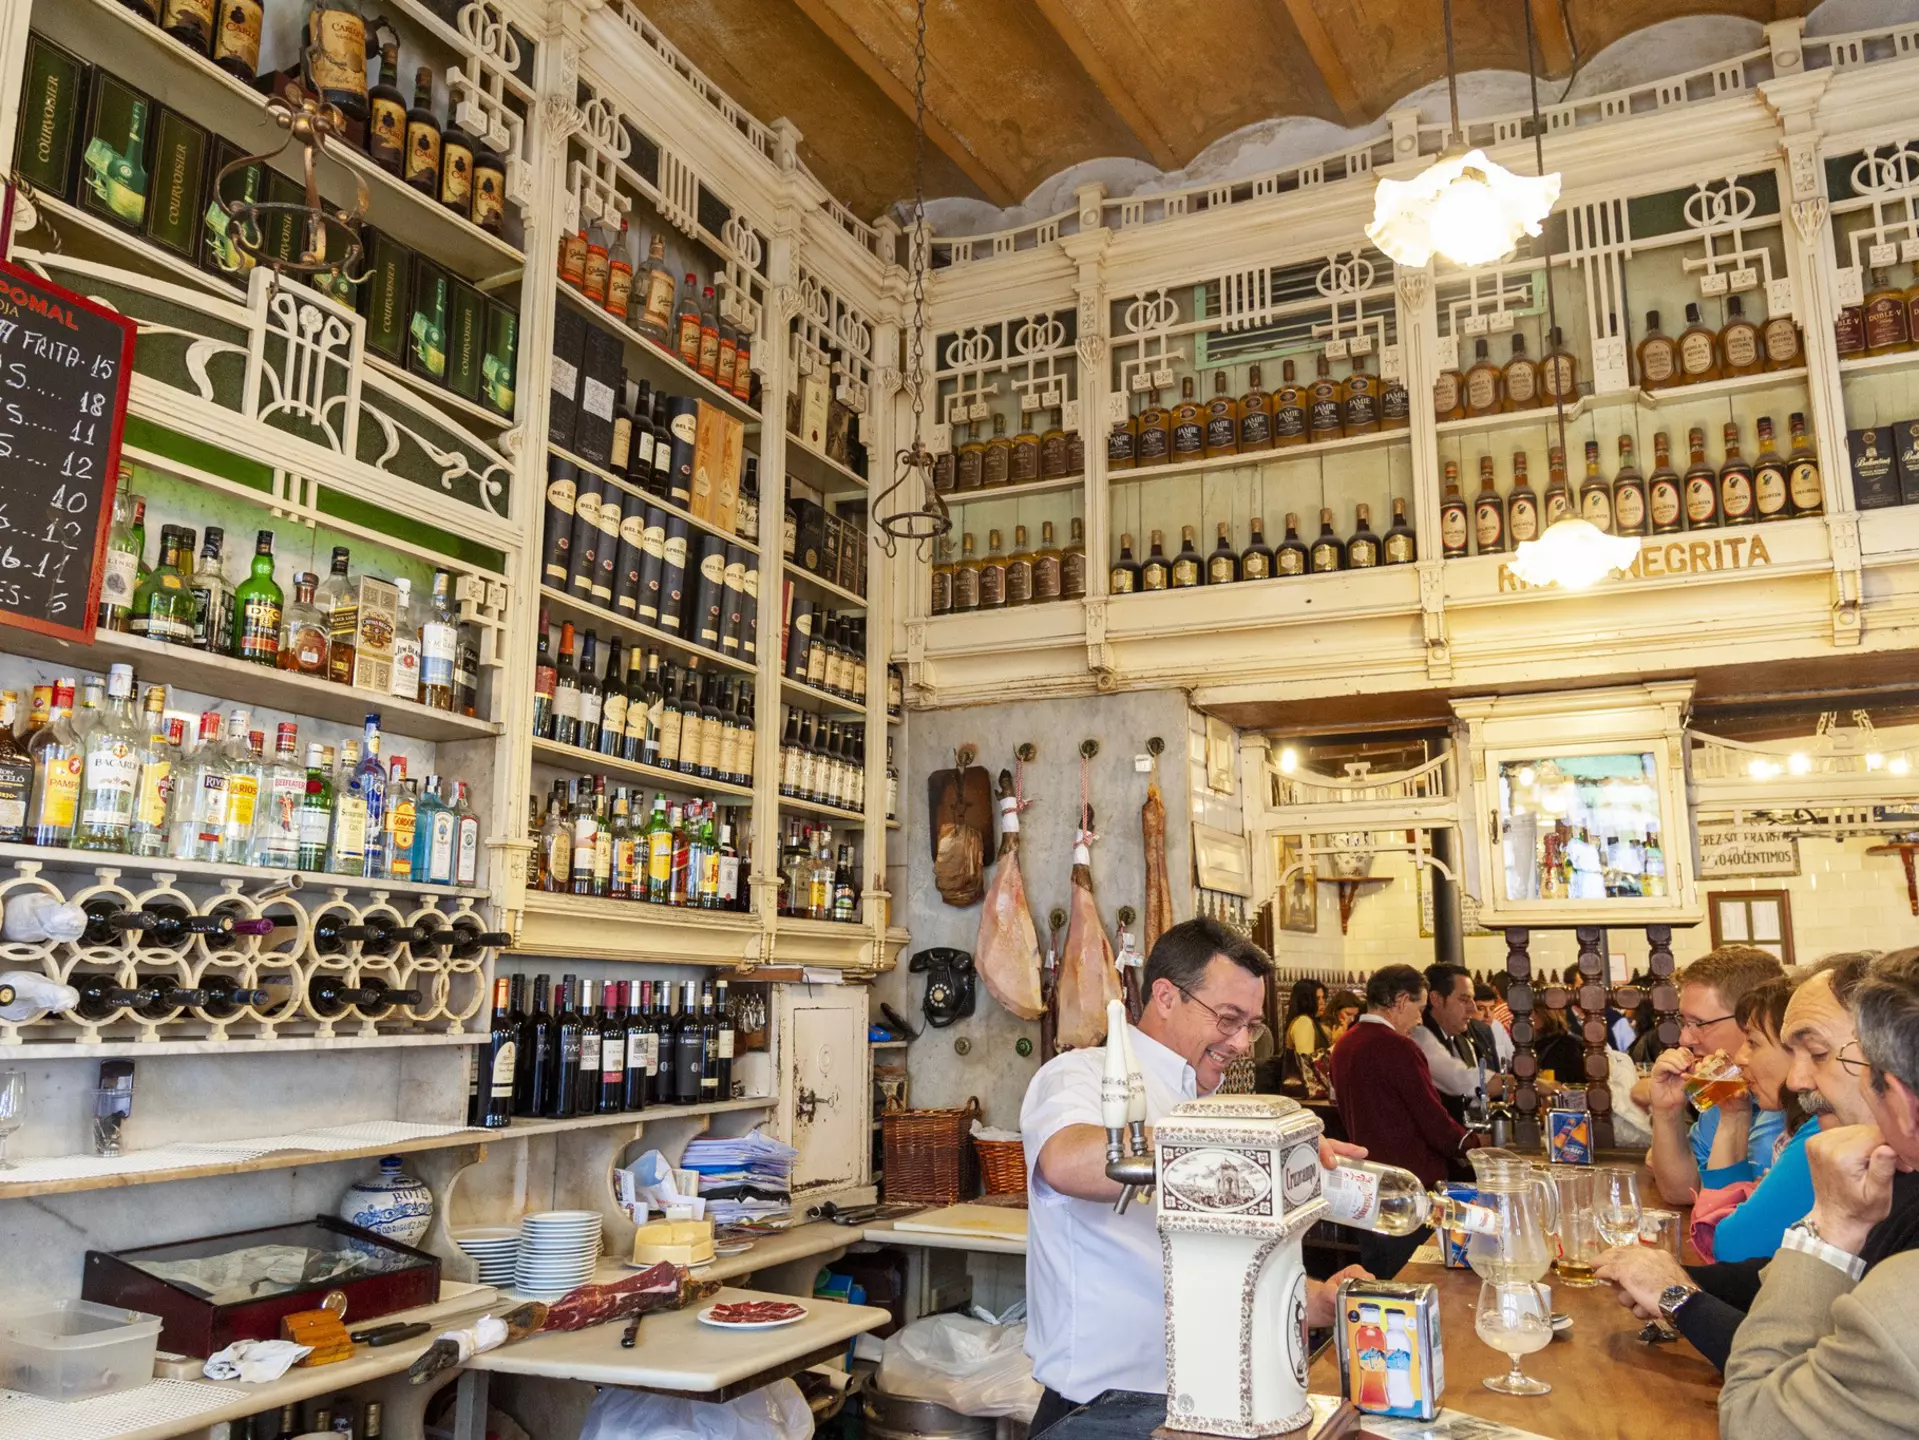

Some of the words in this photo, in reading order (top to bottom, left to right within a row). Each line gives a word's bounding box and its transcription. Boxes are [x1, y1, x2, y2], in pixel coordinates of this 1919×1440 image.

[37, 75, 60, 164] COURVOISIER
[168, 144, 189, 226] COURVOISIER
[382, 262, 396, 334] COURVOISIER
[1868, 310, 1894, 322] DOBLE
[461, 308, 474, 377] COURVOISIER
[90, 354, 116, 380] 15
[79, 391, 106, 417] 18
[68, 420, 96, 446] 11
[60, 451, 93, 480] 12
[50, 483, 88, 514] 10
[248, 606, 281, 620] DYC
[275, 778, 306, 789] BEEFEATER
[1285, 1163, 1317, 1191] Cruzcampo
[392, 1187, 430, 1203] BOTE
